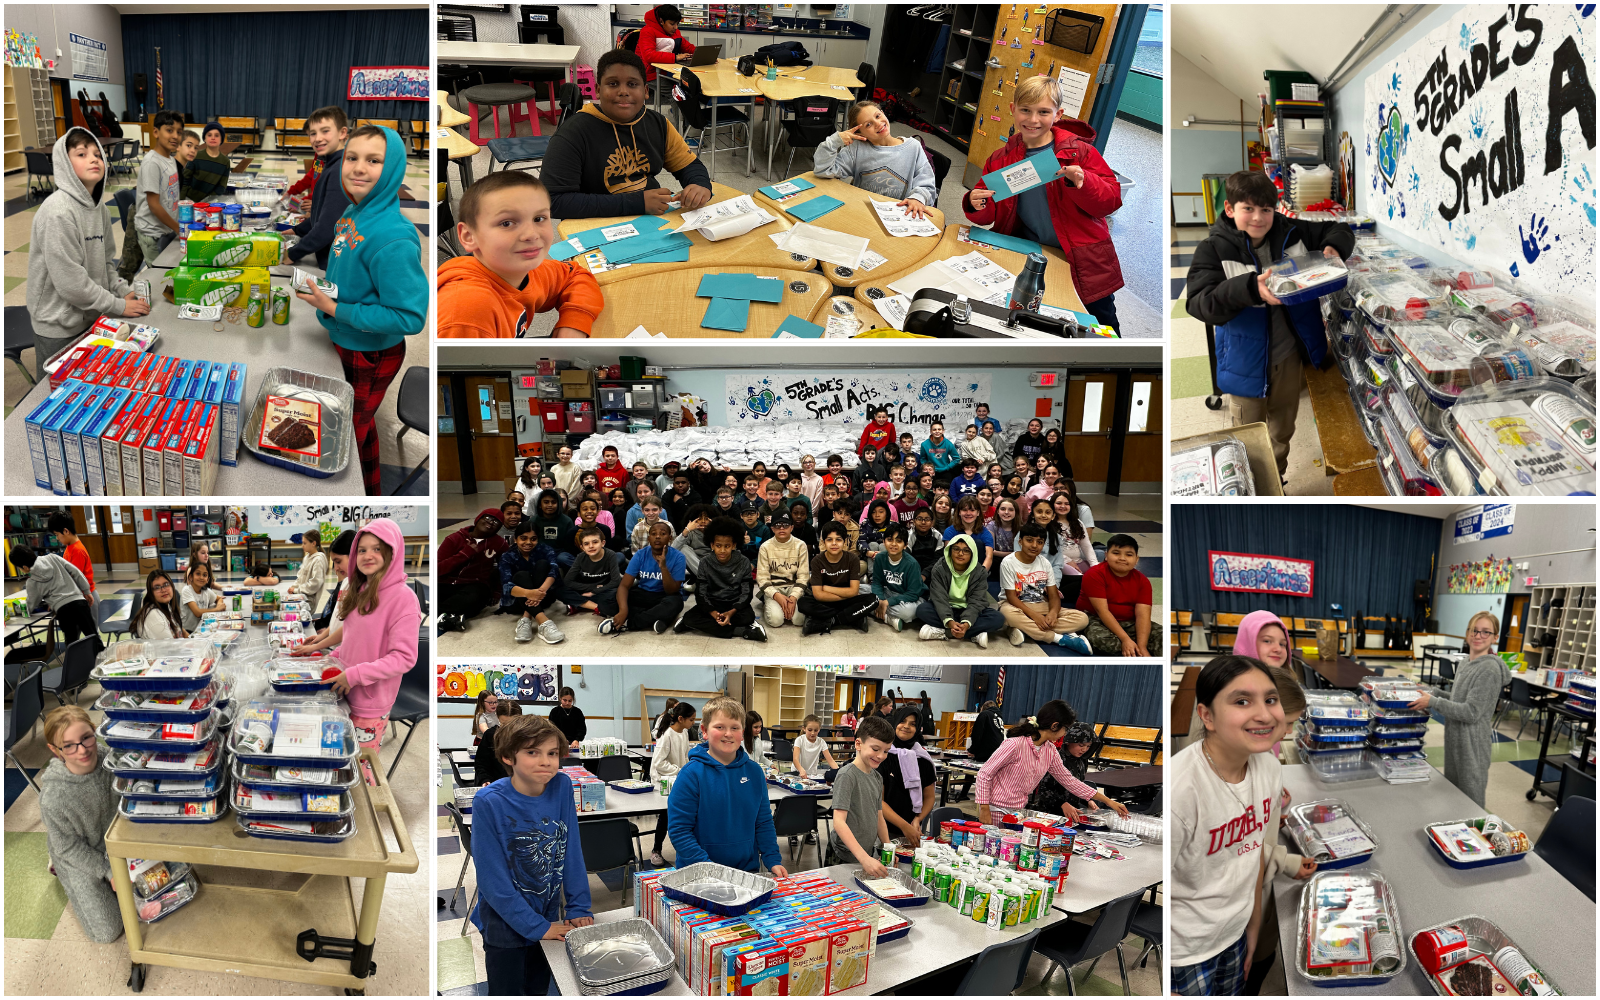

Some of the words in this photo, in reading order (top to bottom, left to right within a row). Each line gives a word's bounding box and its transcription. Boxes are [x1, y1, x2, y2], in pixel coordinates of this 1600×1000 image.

[1430, 4, 1543, 137] GRADE'S
[1414, 45, 1448, 132] 5TH
[1438, 87, 1525, 221] Small
[522, 376, 536, 388] EXIT
[1041, 374, 1056, 386] EXIT
[785, 380, 808, 400] 5TH
[798, 378, 844, 401] GRADE'S
[806, 394, 844, 420] Small
[899, 402, 946, 425] Change
[342, 506, 360, 522] BIG
[900, 511, 915, 522] HARV
[1486, 508, 1502, 520] CLASS
[1504, 506, 1512, 516] OF
[1458, 517, 1472, 528] CLASS
[1472, 516, 1480, 524] OF
[1490, 518, 1504, 528] 2024
[1462, 526, 1473, 535] 2023
[1214, 558, 1308, 592] Acceptance
[768, 958, 786, 967] MOIST
